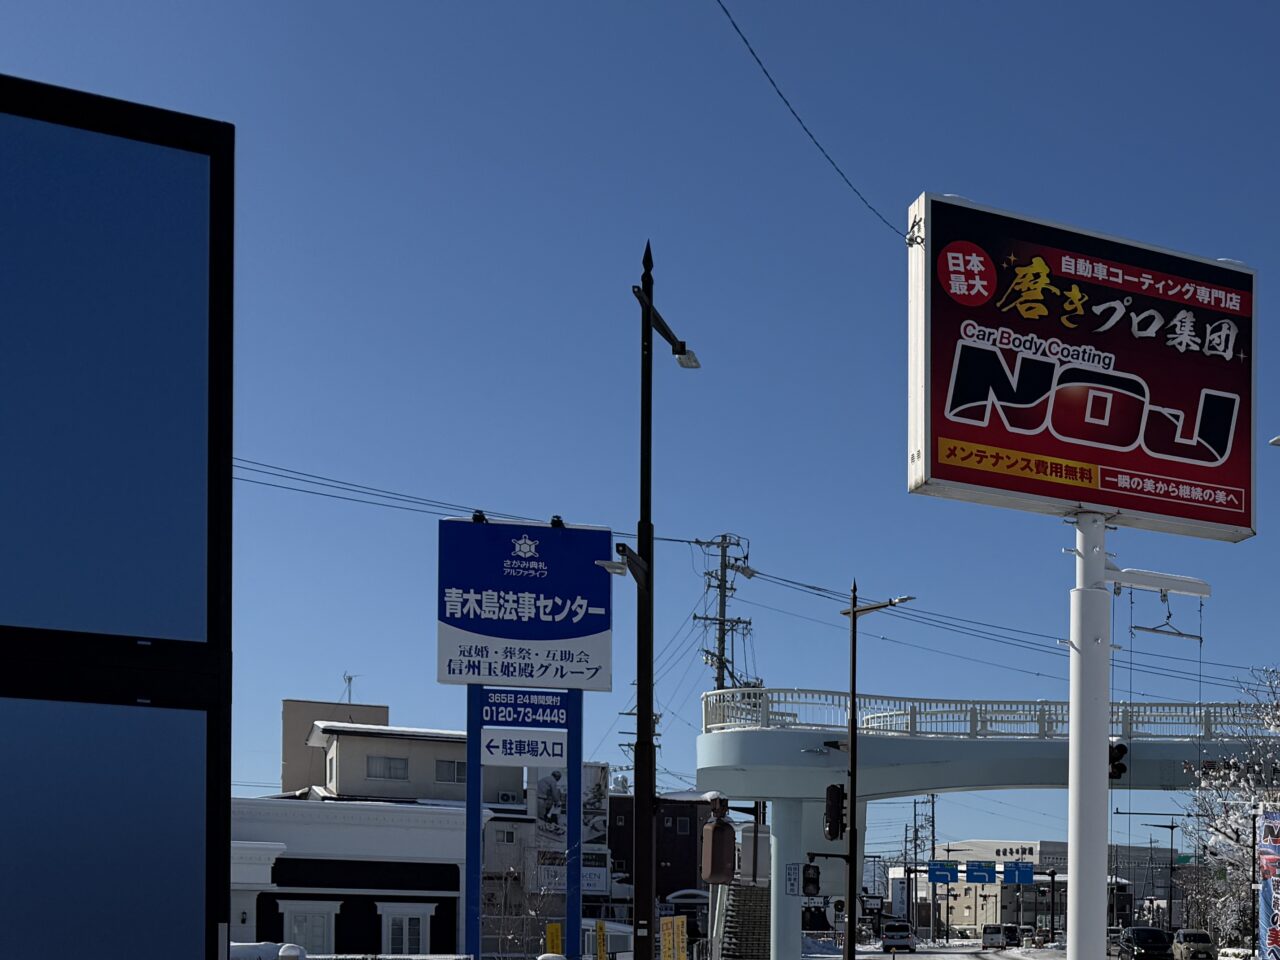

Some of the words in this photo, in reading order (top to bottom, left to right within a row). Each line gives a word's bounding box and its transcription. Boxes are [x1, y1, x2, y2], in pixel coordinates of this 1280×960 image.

[946, 251, 985, 275] 日本
[949, 274, 989, 298] 最大
[1060, 255, 1242, 311] 自動車コーティング専門店
[996, 256, 1240, 362] 磨きプロ集団
[961, 320, 995, 344] Car
[998, 328, 1046, 356] Body
[1045, 338, 1114, 371] Coating
[944, 338, 1240, 468] NOJ
[944, 443, 1094, 484] メンテナンス費用無料
[1105, 472, 1240, 506] 一瞬の美から継続の美へ
[503, 559, 547, 570] さがみ典礼
[503, 568, 547, 578] アルファライフ
[444, 587, 606, 624] 青木島法事センター
[458, 644, 590, 664] 冠婚・葬祭・互助会
[447, 658, 602, 681] 信州玉姫殿グループ
[488, 693, 515, 704] 365日
[517, 694, 561, 706] 24時間受付
[482, 706, 566, 724] 0120-73-4449
[502, 738, 563, 758] 駐車場入口
